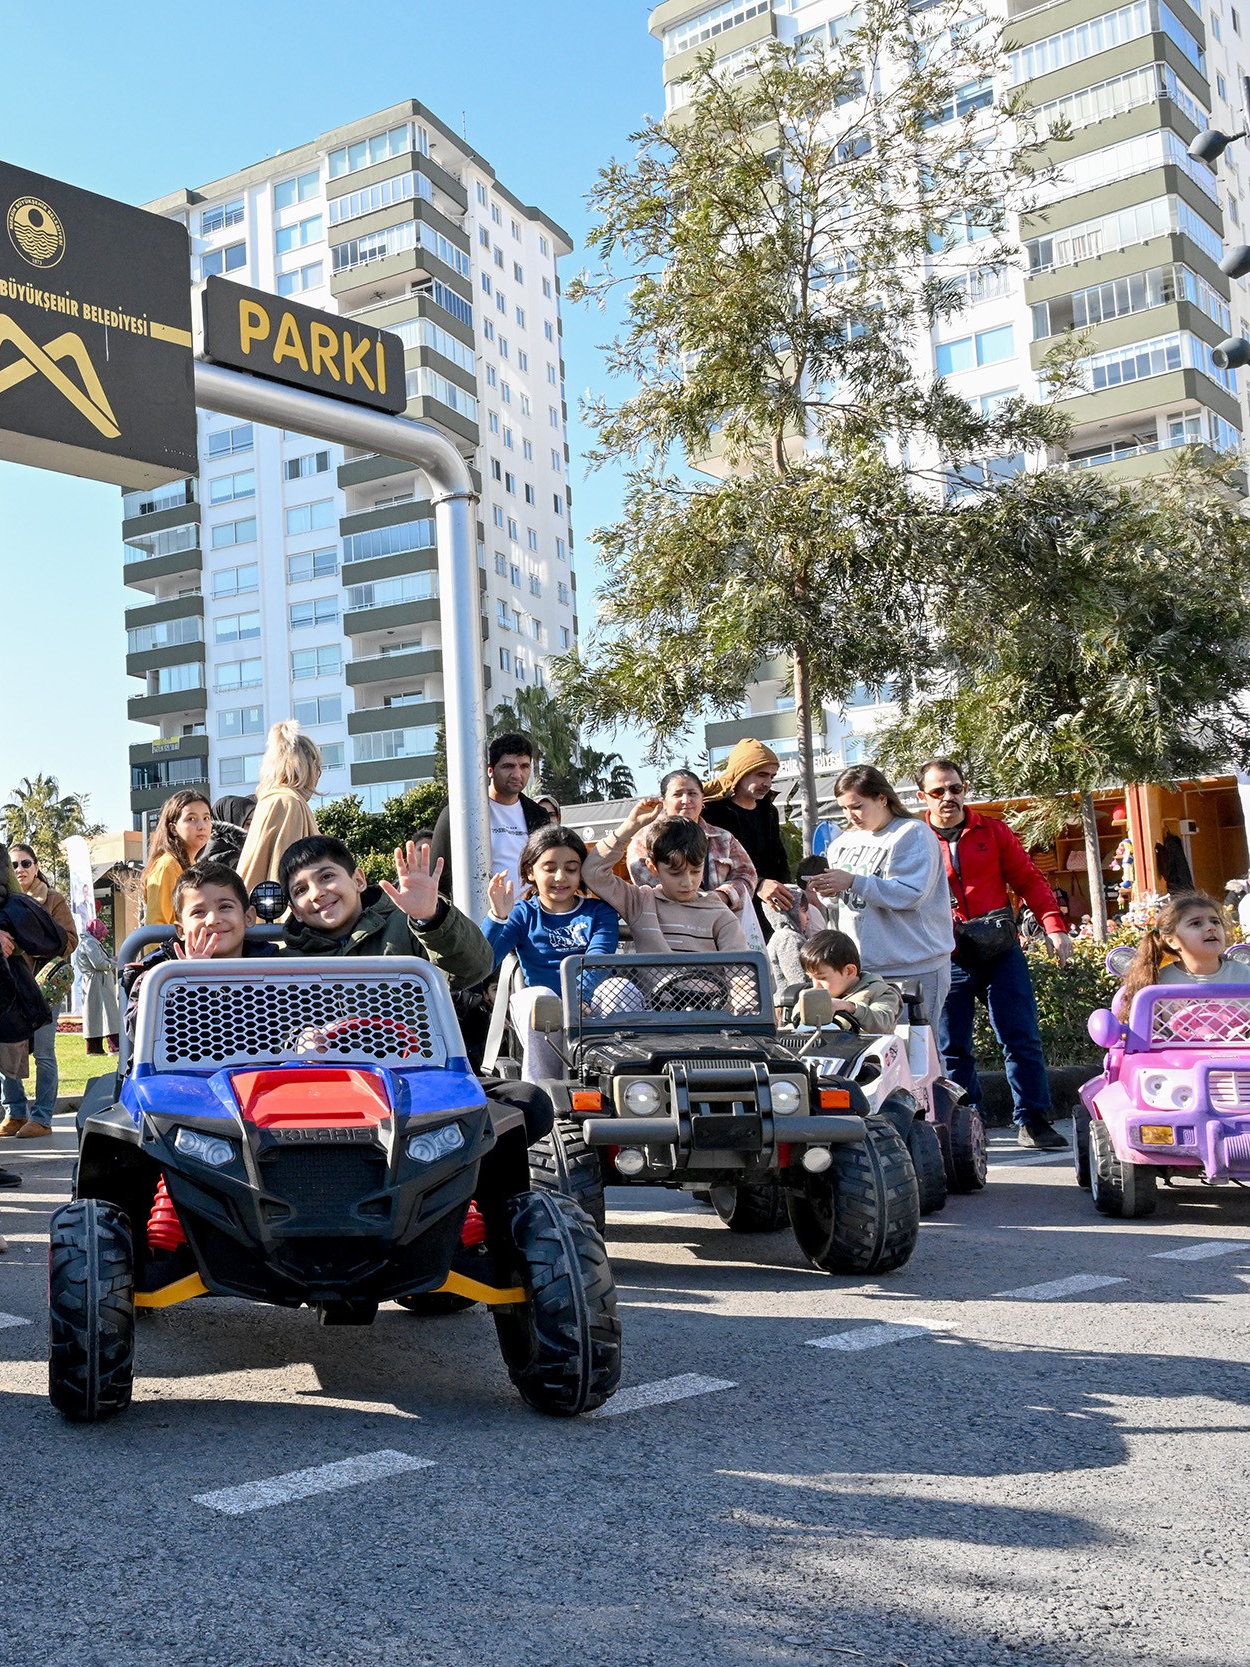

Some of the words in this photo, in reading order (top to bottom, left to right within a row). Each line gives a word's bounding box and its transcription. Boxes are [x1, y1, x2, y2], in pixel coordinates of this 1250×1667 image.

[0, 277, 79, 318] BÜYÜKŞEHİR
[82, 302, 148, 337] BELEDİYESİ
[269, 1127, 375, 1142] POLARIS
